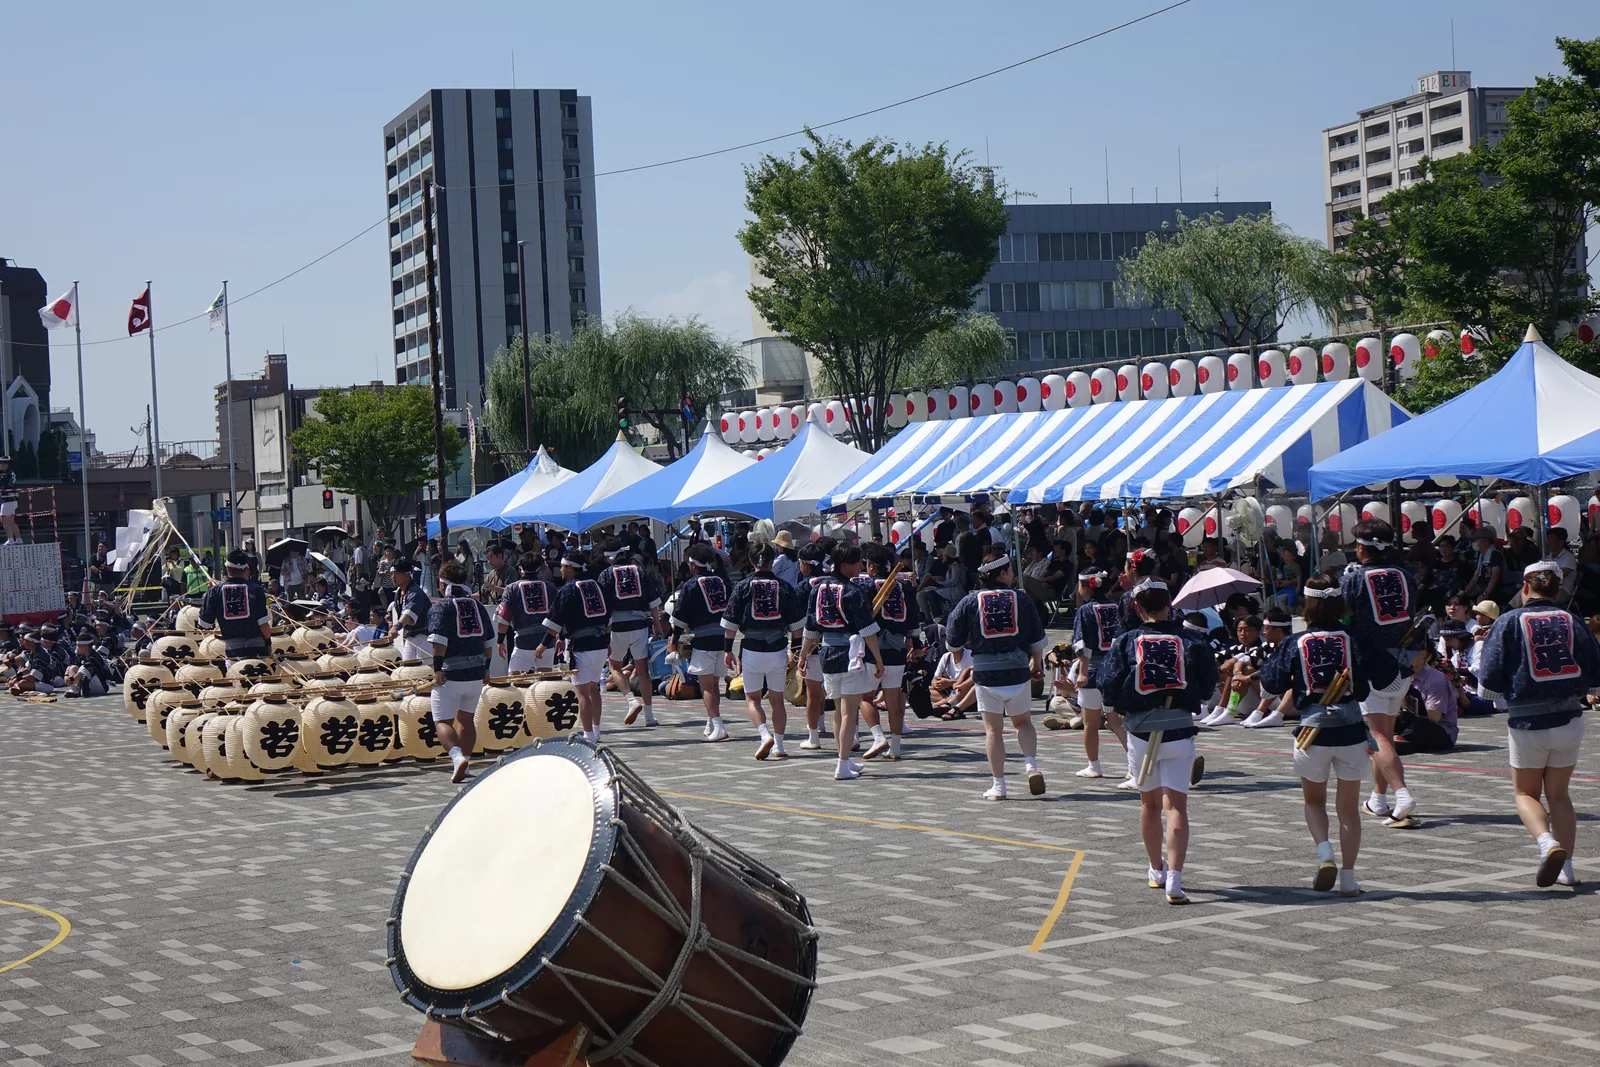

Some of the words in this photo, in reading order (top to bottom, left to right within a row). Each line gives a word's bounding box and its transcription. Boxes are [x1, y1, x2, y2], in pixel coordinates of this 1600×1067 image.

[1420, 77, 1438, 92] EIR
[1442, 75, 1469, 87] EIR
[983, 593, 1014, 633] 勝平
[1369, 573, 1406, 618] 勝平
[1139, 641, 1181, 688] 勝平
[1526, 616, 1576, 674] 勝平
[488, 701, 524, 739] 若
[545, 690, 579, 731] 若
[260, 719, 299, 759] 若
[320, 715, 358, 755] 若
[358, 715, 393, 752] 若
